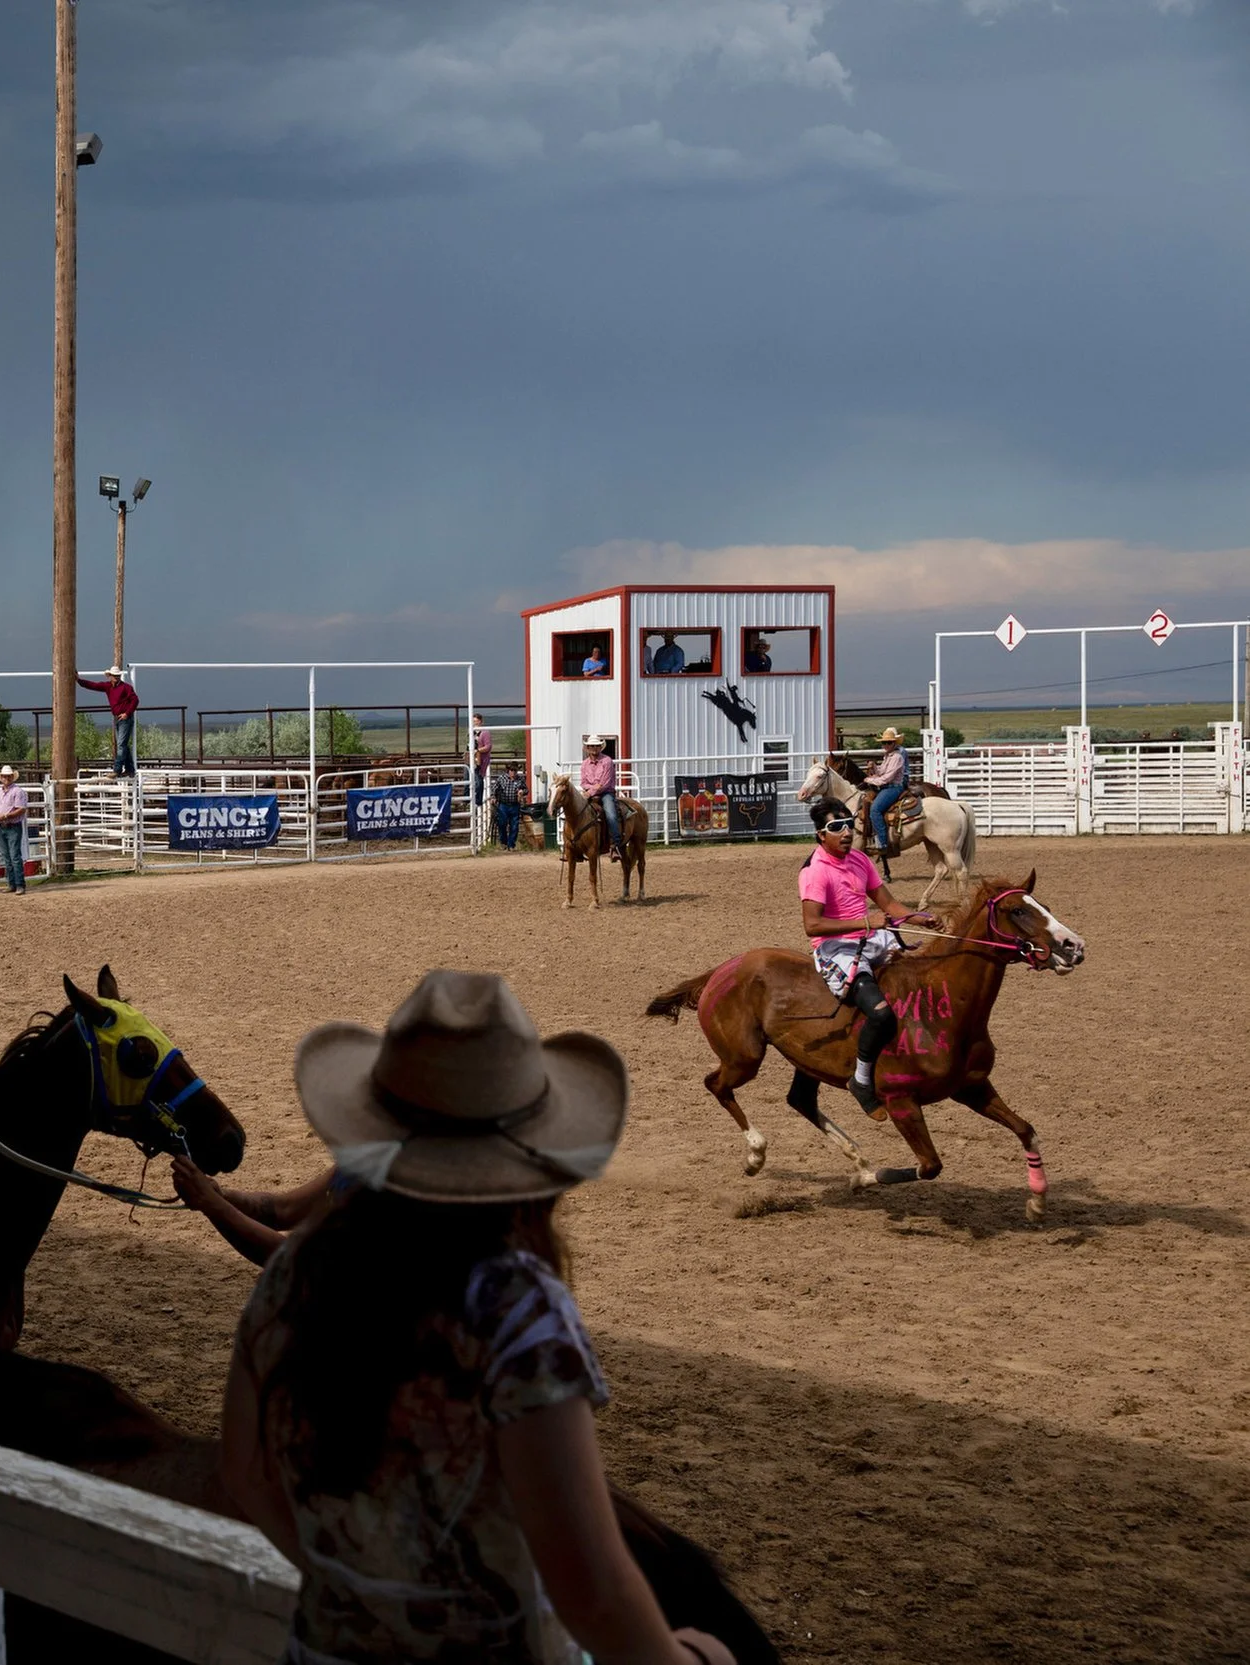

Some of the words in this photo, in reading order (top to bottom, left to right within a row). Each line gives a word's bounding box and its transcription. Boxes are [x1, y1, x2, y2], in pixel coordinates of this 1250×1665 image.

[1007, 621, 1014, 645] 1
[1150, 614, 1168, 638] 2
[178, 807, 269, 827] CINCH
[356, 796, 440, 819] CINCH
[179, 829, 213, 840] JEANS
[215, 829, 225, 838] &
[227, 828, 266, 838] SHIRTS
[356, 820, 390, 831] JEANS
[389, 819, 397, 827] &
